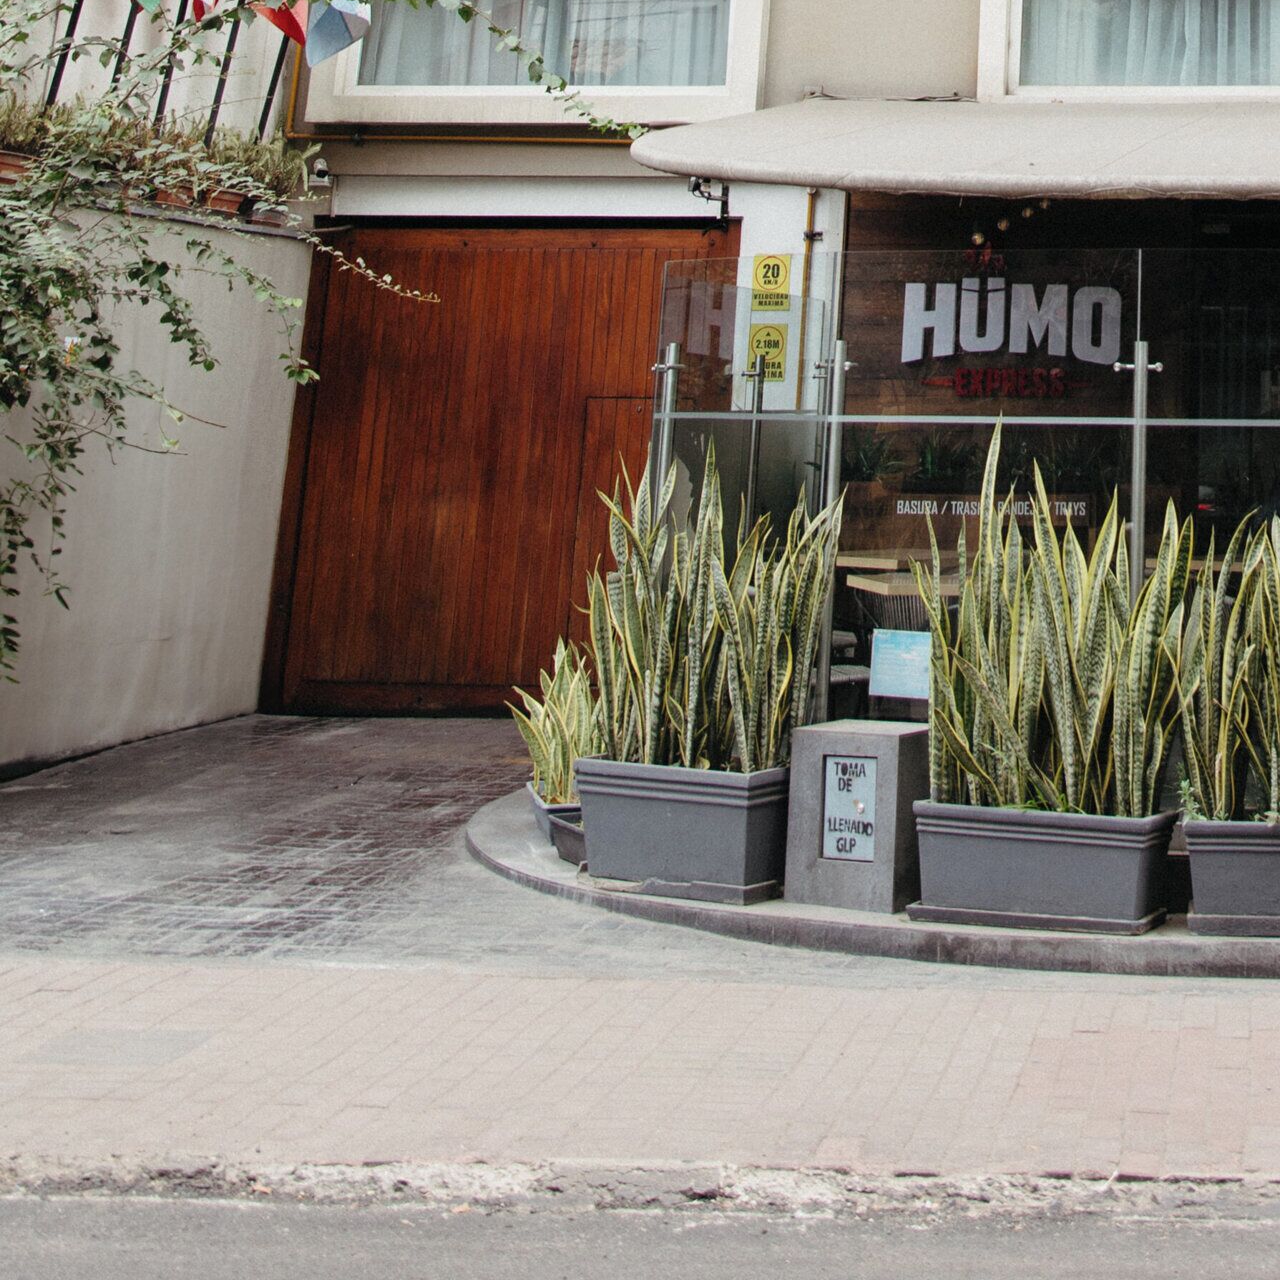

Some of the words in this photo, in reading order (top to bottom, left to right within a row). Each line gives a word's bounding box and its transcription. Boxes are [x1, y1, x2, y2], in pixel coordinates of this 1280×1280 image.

[762, 263, 780, 279] 20
[901, 277, 1122, 366] HÜMO
[756, 339, 780, 349] 2.18M
[750, 361, 782, 370] AURA
[955, 367, 1067, 398] EXPRESS
[896, 499, 938, 515] BASURA
[834, 762, 866, 777] TOMA
[838, 778, 853, 792] DE
[828, 817, 873, 837] LLENADO
[836, 837, 857, 853] GLP
